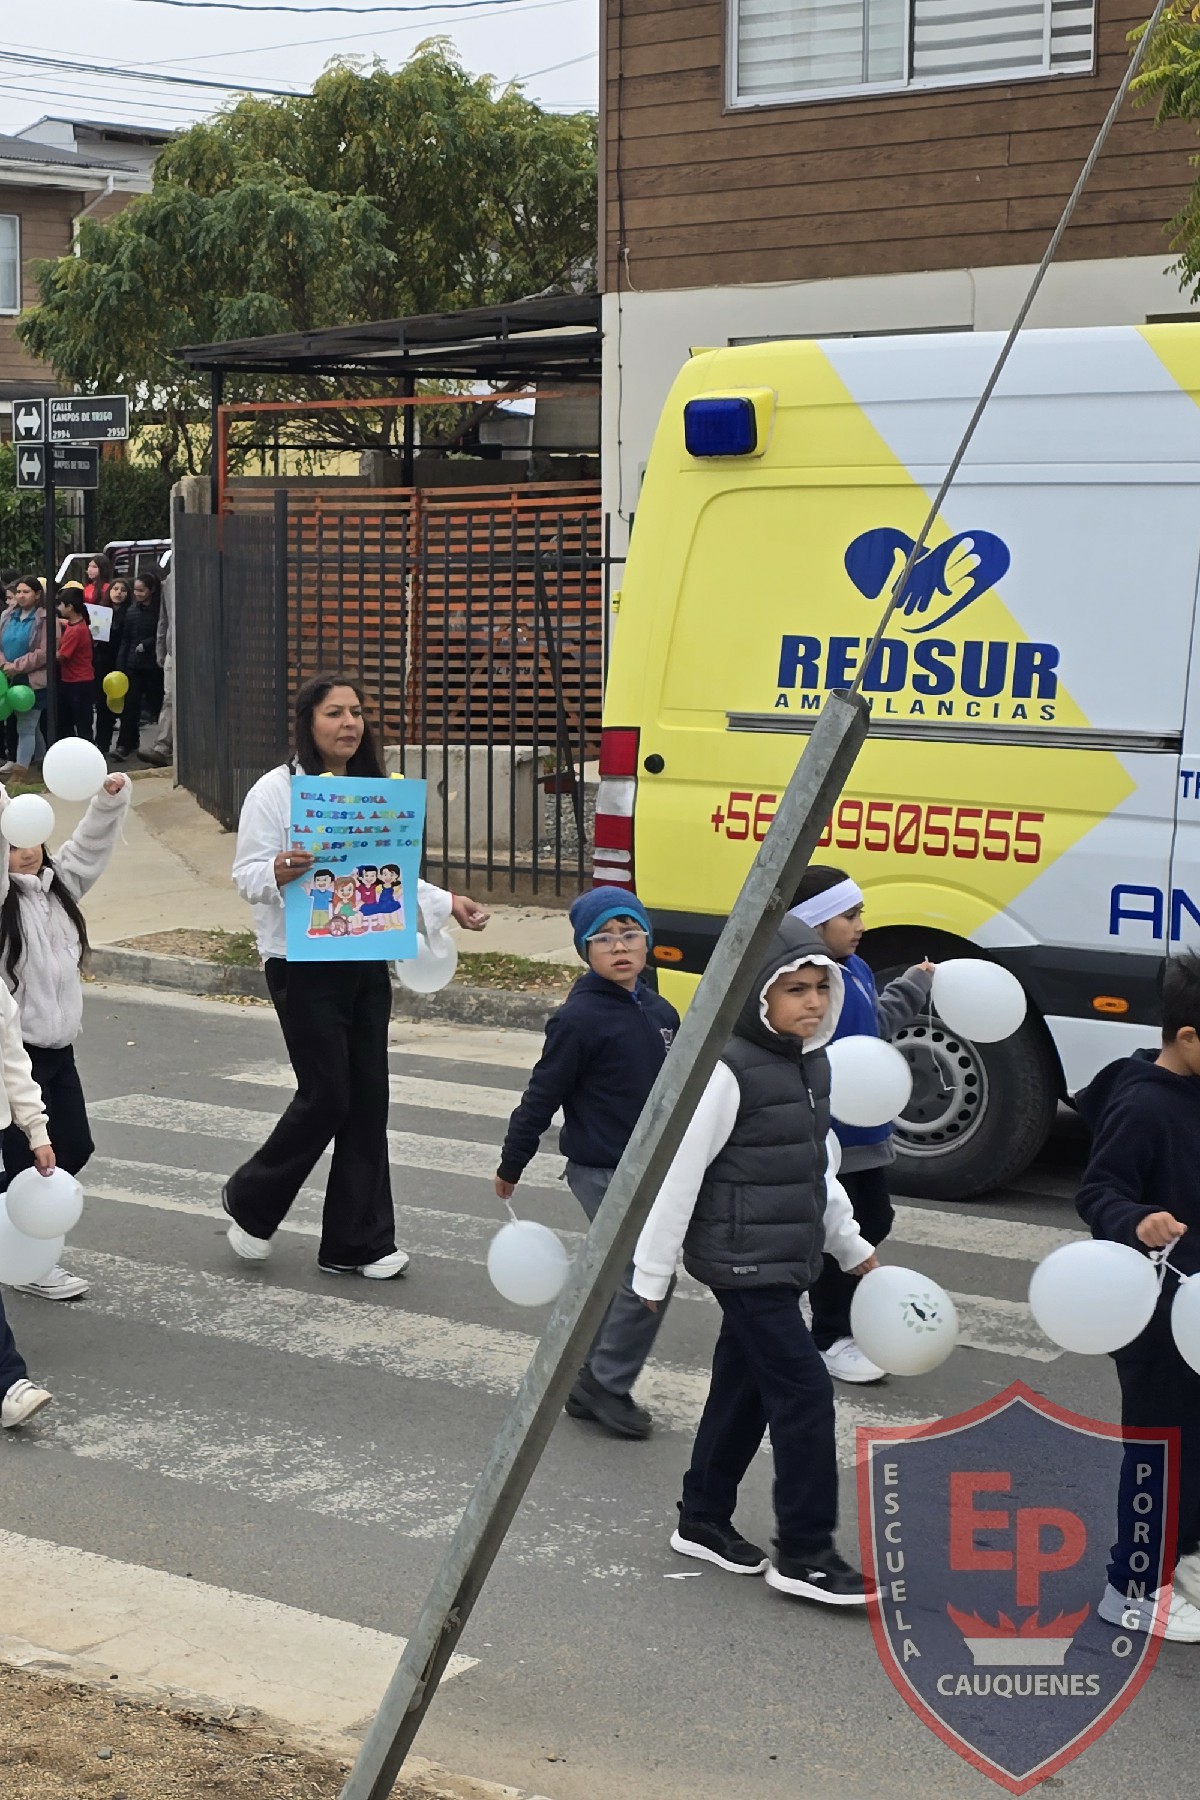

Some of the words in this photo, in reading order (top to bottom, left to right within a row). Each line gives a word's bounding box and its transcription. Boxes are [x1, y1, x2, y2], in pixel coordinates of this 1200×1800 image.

[52, 402, 72, 412] CALLE
[52, 412, 80, 423] CAMPOS
[81, 412, 91, 422] DE
[92, 411, 113, 422] TRIGO
[53, 460, 71, 470] AMPOS
[776, 634, 1061, 700] REDSUR
[774, 692, 1056, 721] AMLANCIAS
[329, 793, 387, 804] PERSONA
[306, 809, 365, 820] HONESTA
[292, 824, 313, 833] LA
[711, 791, 1045, 864] +569505555
